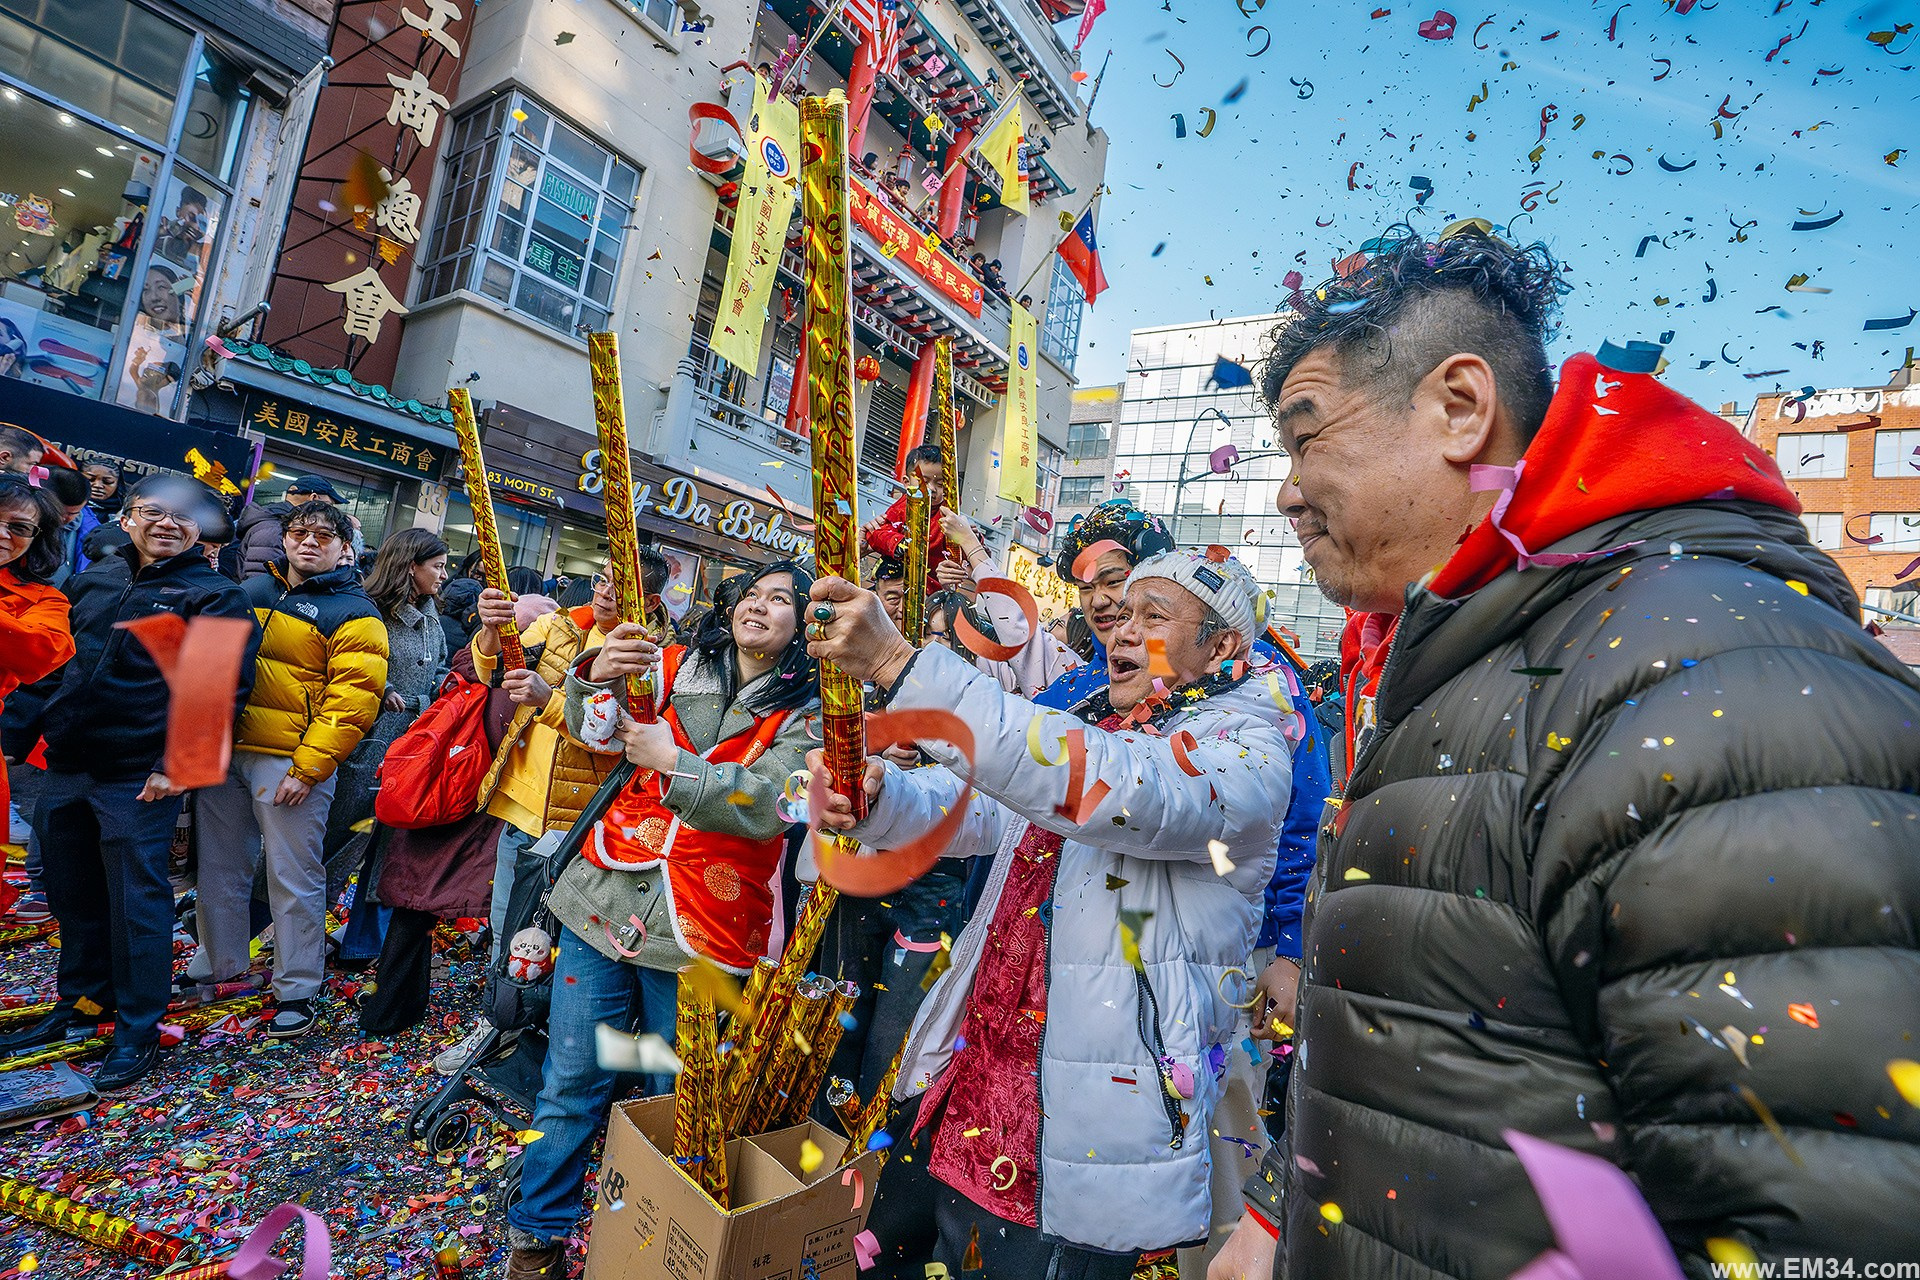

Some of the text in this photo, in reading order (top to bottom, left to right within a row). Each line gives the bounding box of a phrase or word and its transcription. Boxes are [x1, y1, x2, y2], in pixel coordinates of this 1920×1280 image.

[542, 171, 596, 221] FISHION
[254, 400, 437, 472] 美國安良工商會
[417, 481, 450, 516] 83
[487, 470, 556, 500] 83 MOTT ST.
[654, 476, 711, 527] Da
[716, 499, 817, 564] Bakery
